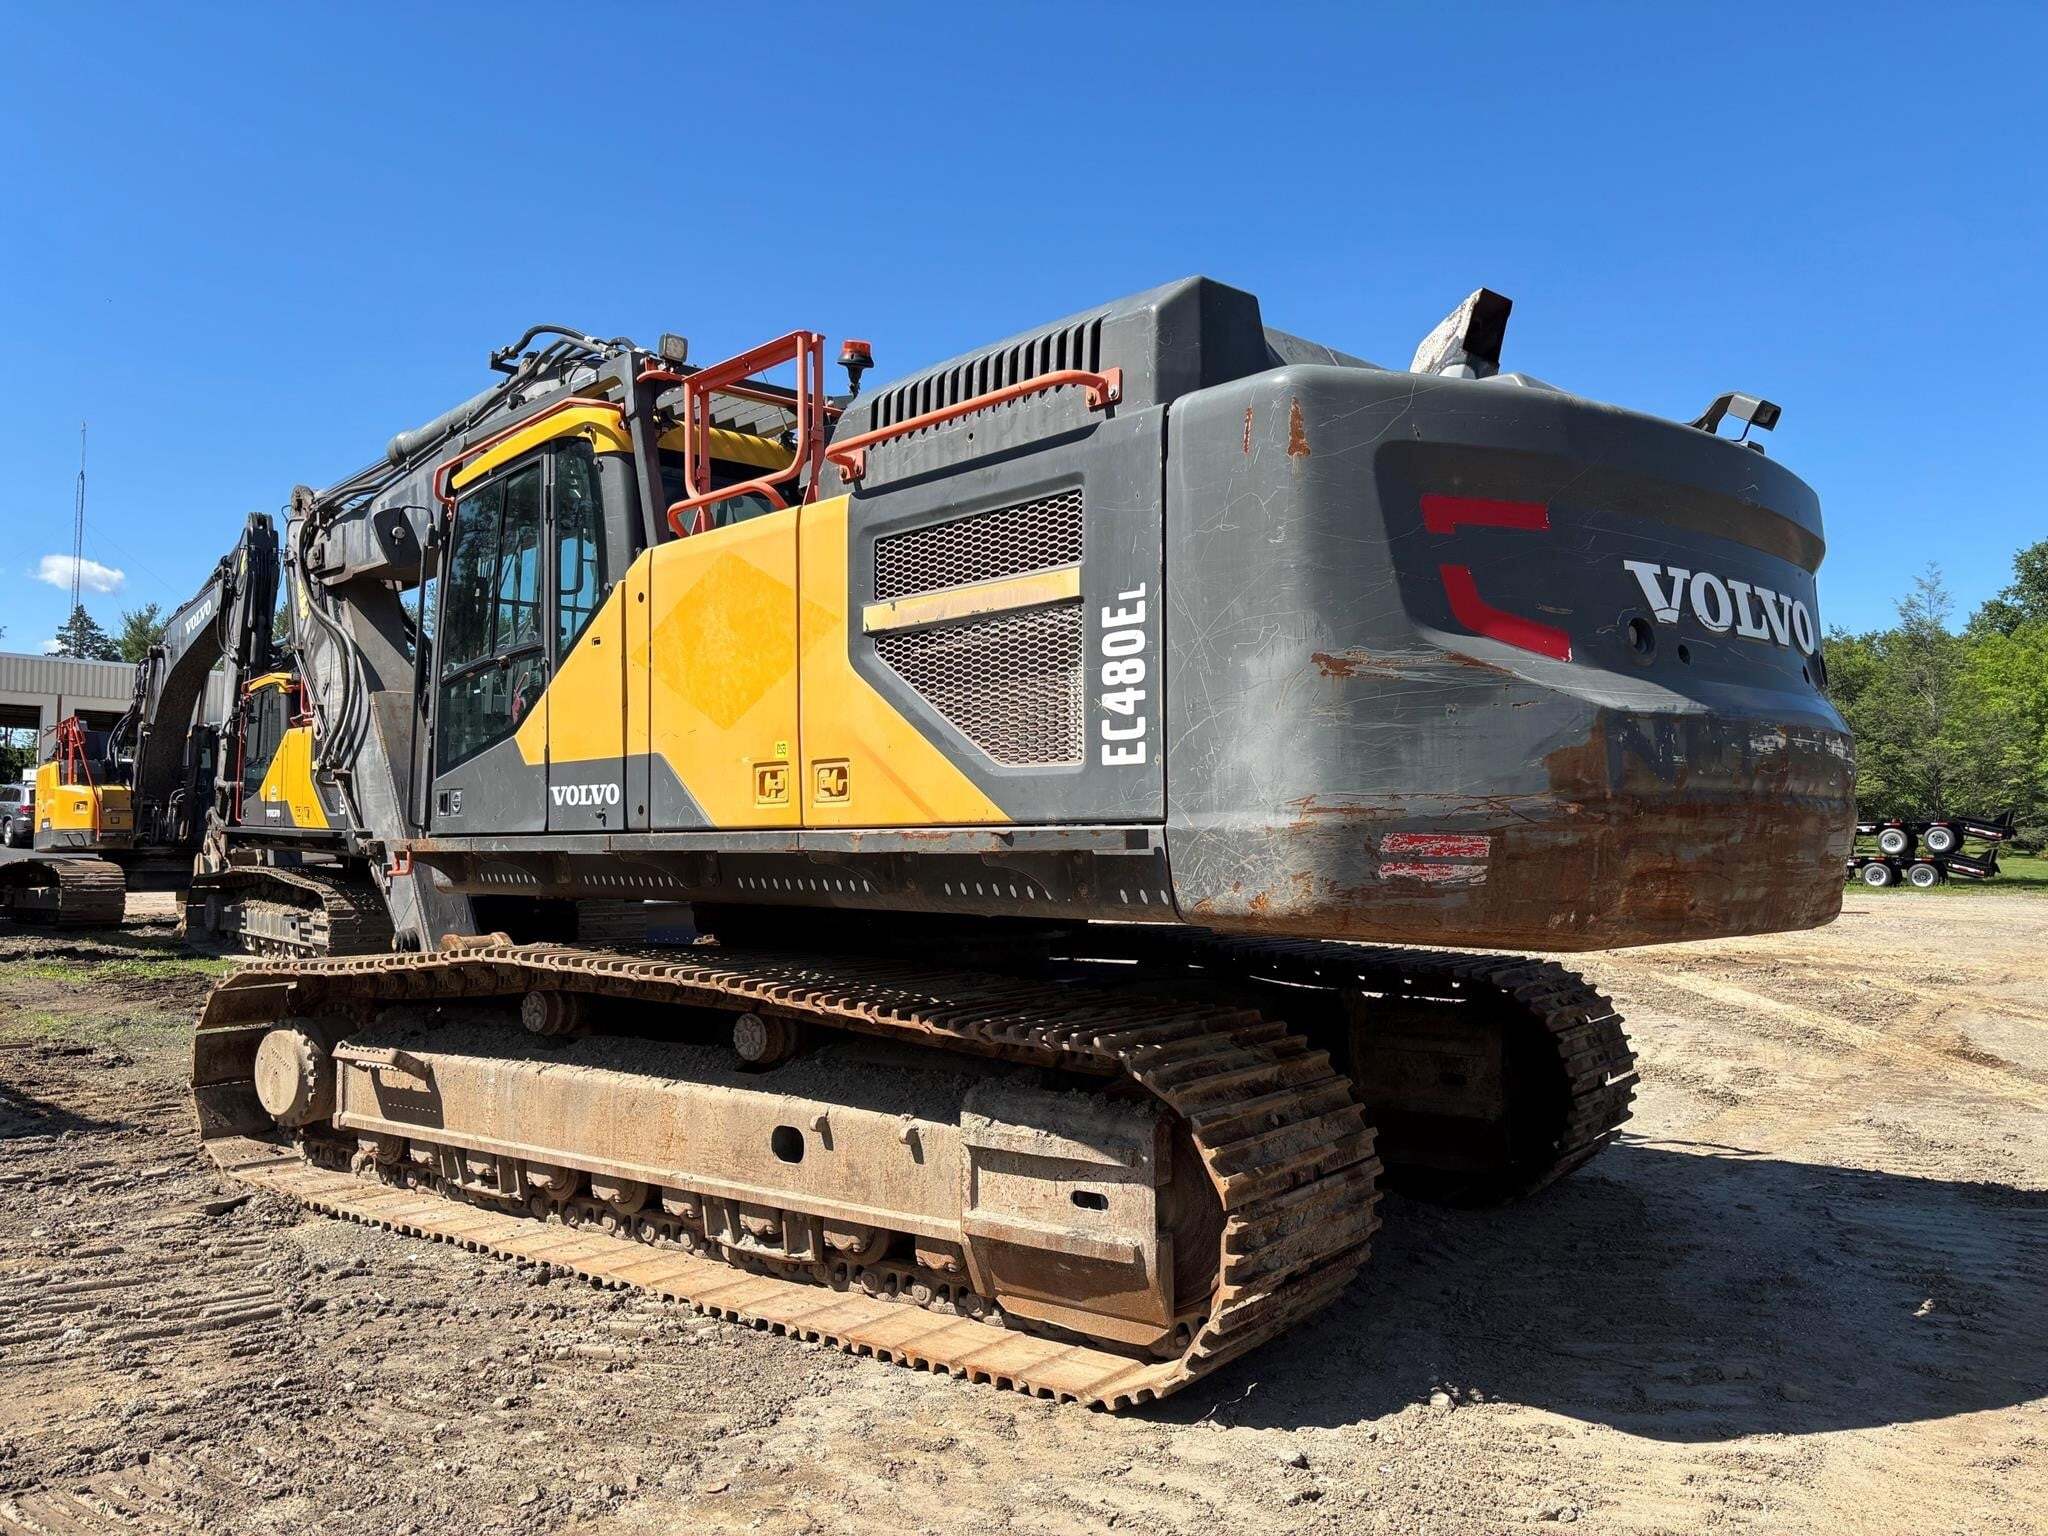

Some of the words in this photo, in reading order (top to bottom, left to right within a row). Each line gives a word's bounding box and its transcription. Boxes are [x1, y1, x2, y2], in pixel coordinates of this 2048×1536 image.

[185, 599, 212, 635] VOLVO
[1623, 559, 1815, 655] VOLVO
[1101, 582, 1146, 766] EC480EL
[550, 783, 620, 806] VOLVO
